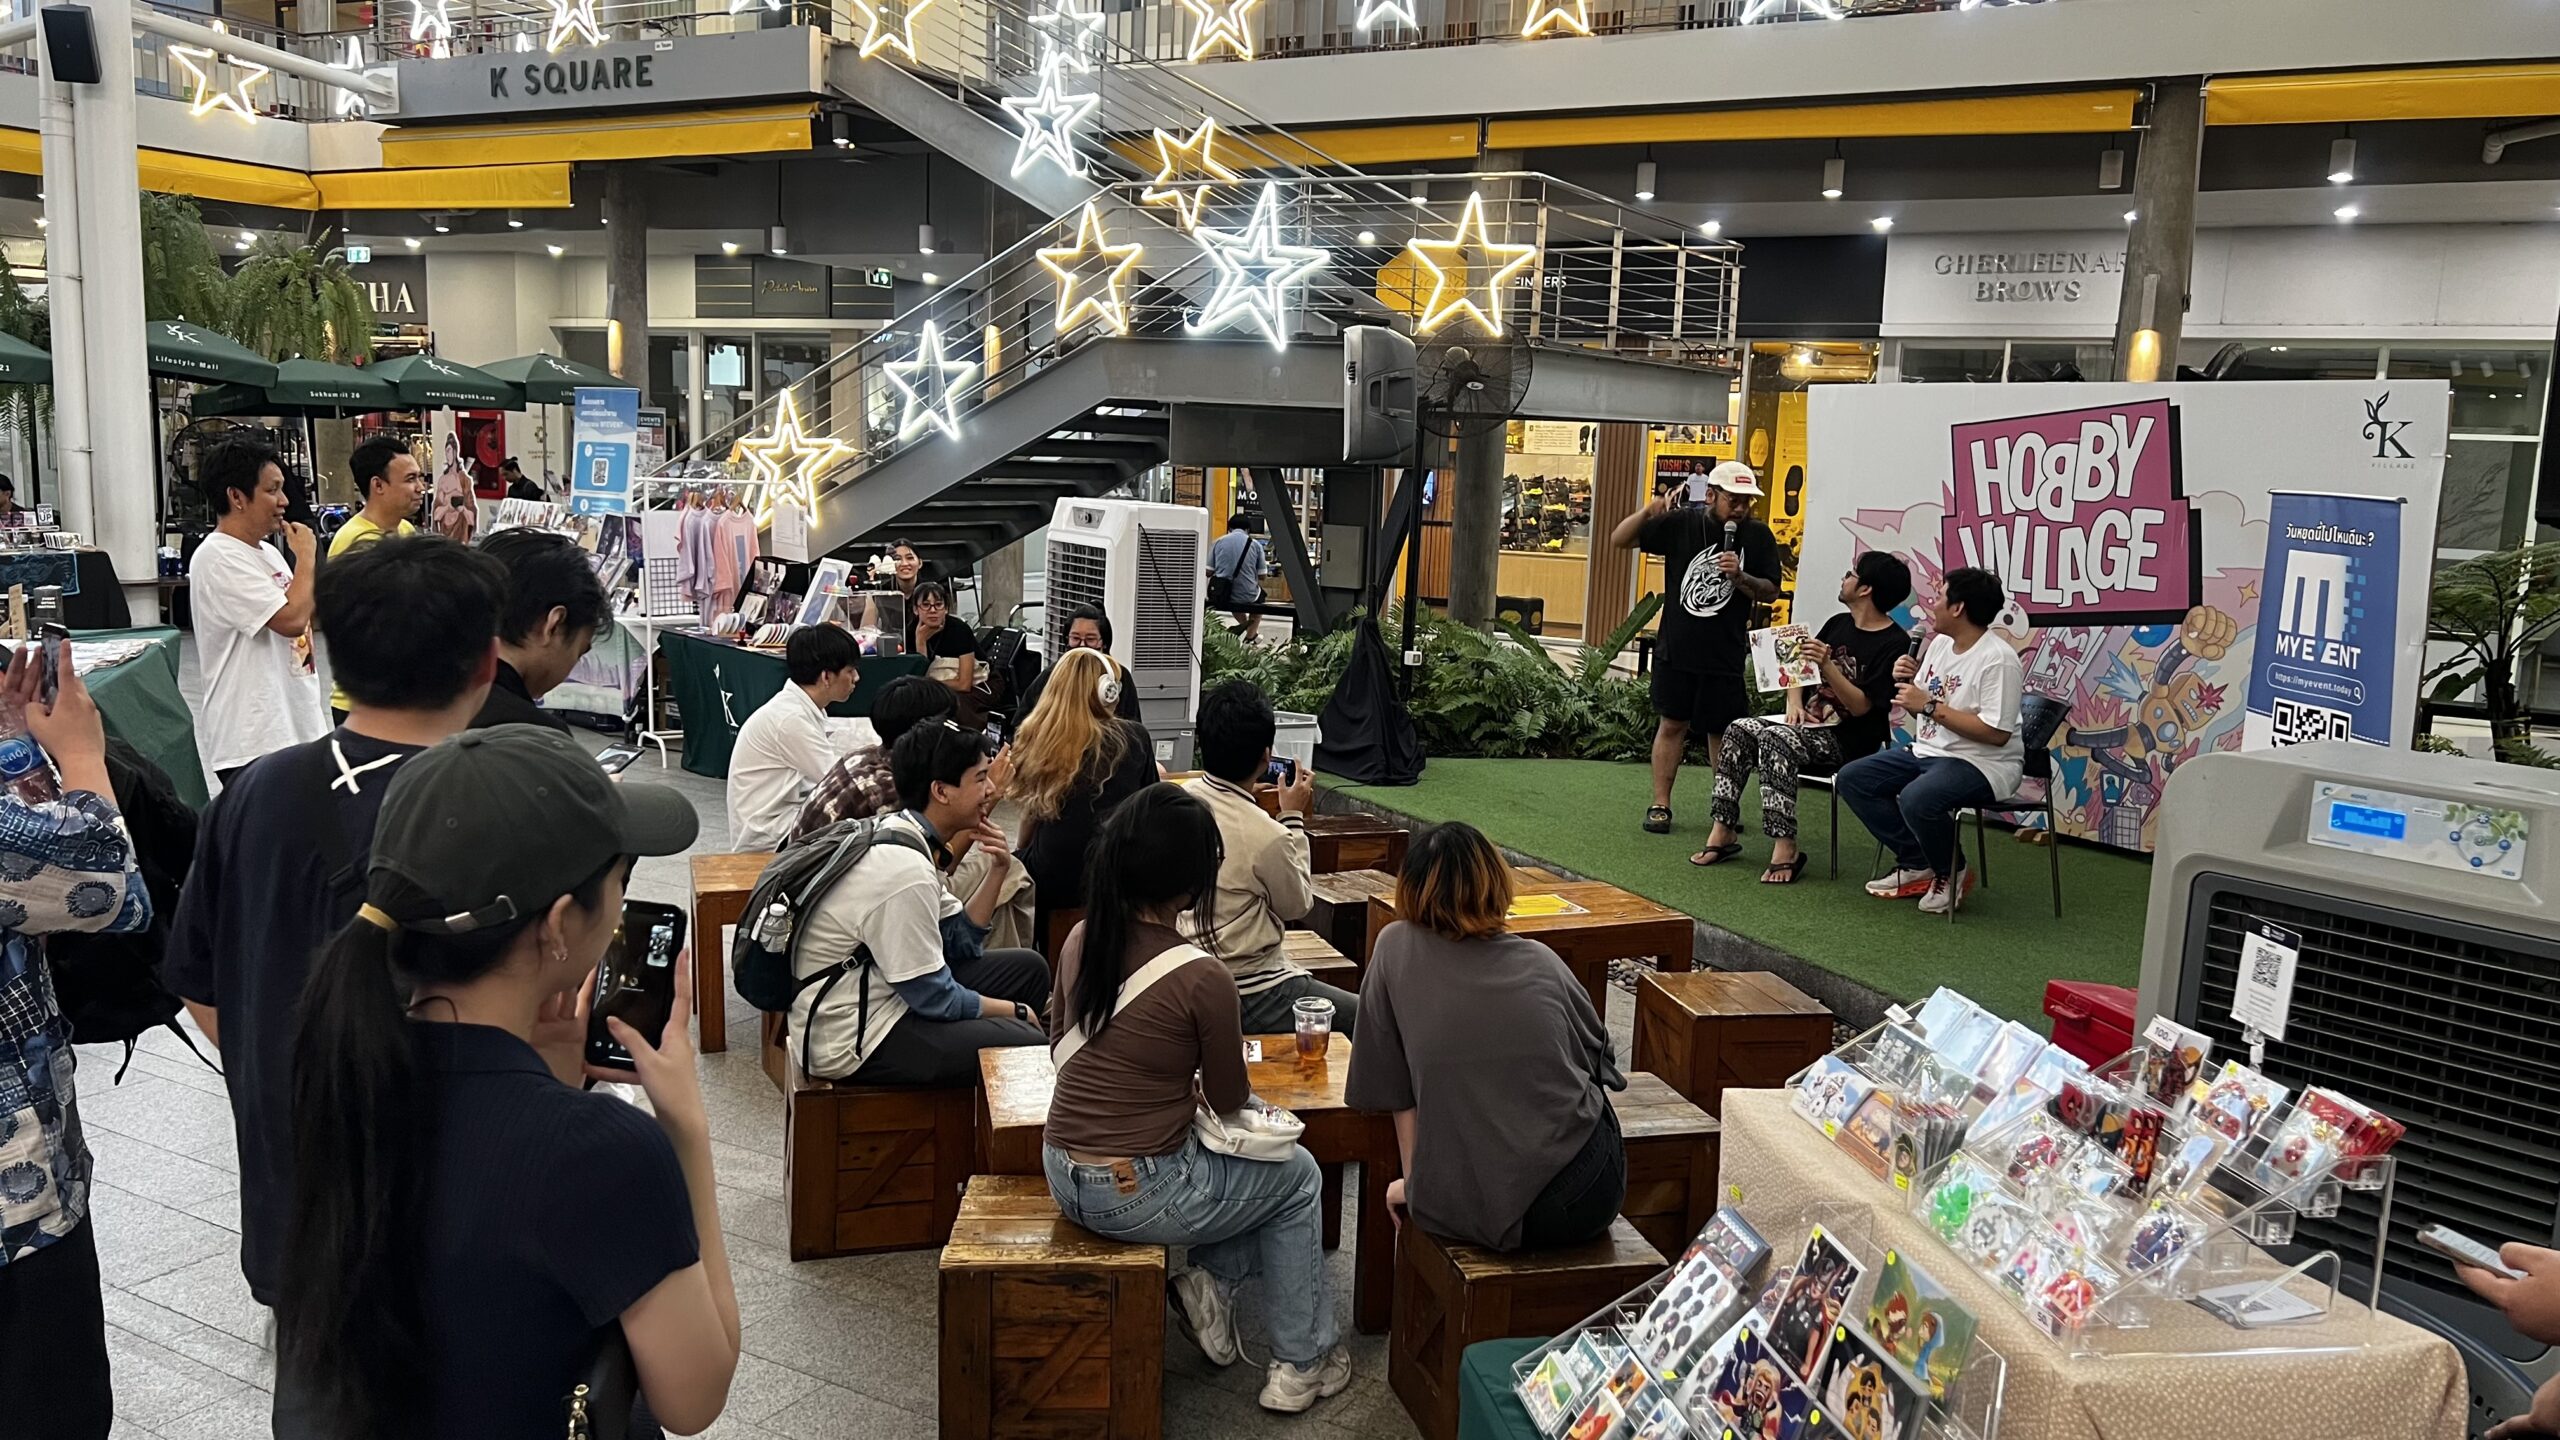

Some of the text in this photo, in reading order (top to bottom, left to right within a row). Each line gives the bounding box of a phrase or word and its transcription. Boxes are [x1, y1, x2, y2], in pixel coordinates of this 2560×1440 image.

[490, 55, 653, 97] K SQUARE
[1975, 280, 2082, 302] BROWS
[155, 354, 220, 371] Lifestyle Mall
[1658, 458, 1691, 472] YOSHI'S
[1970, 412, 2156, 524] HOBBY
[39, 513, 52, 522] UP
[1957, 507, 2166, 608] VILLAGE
[2274, 671, 2352, 698] https://myevent.today
